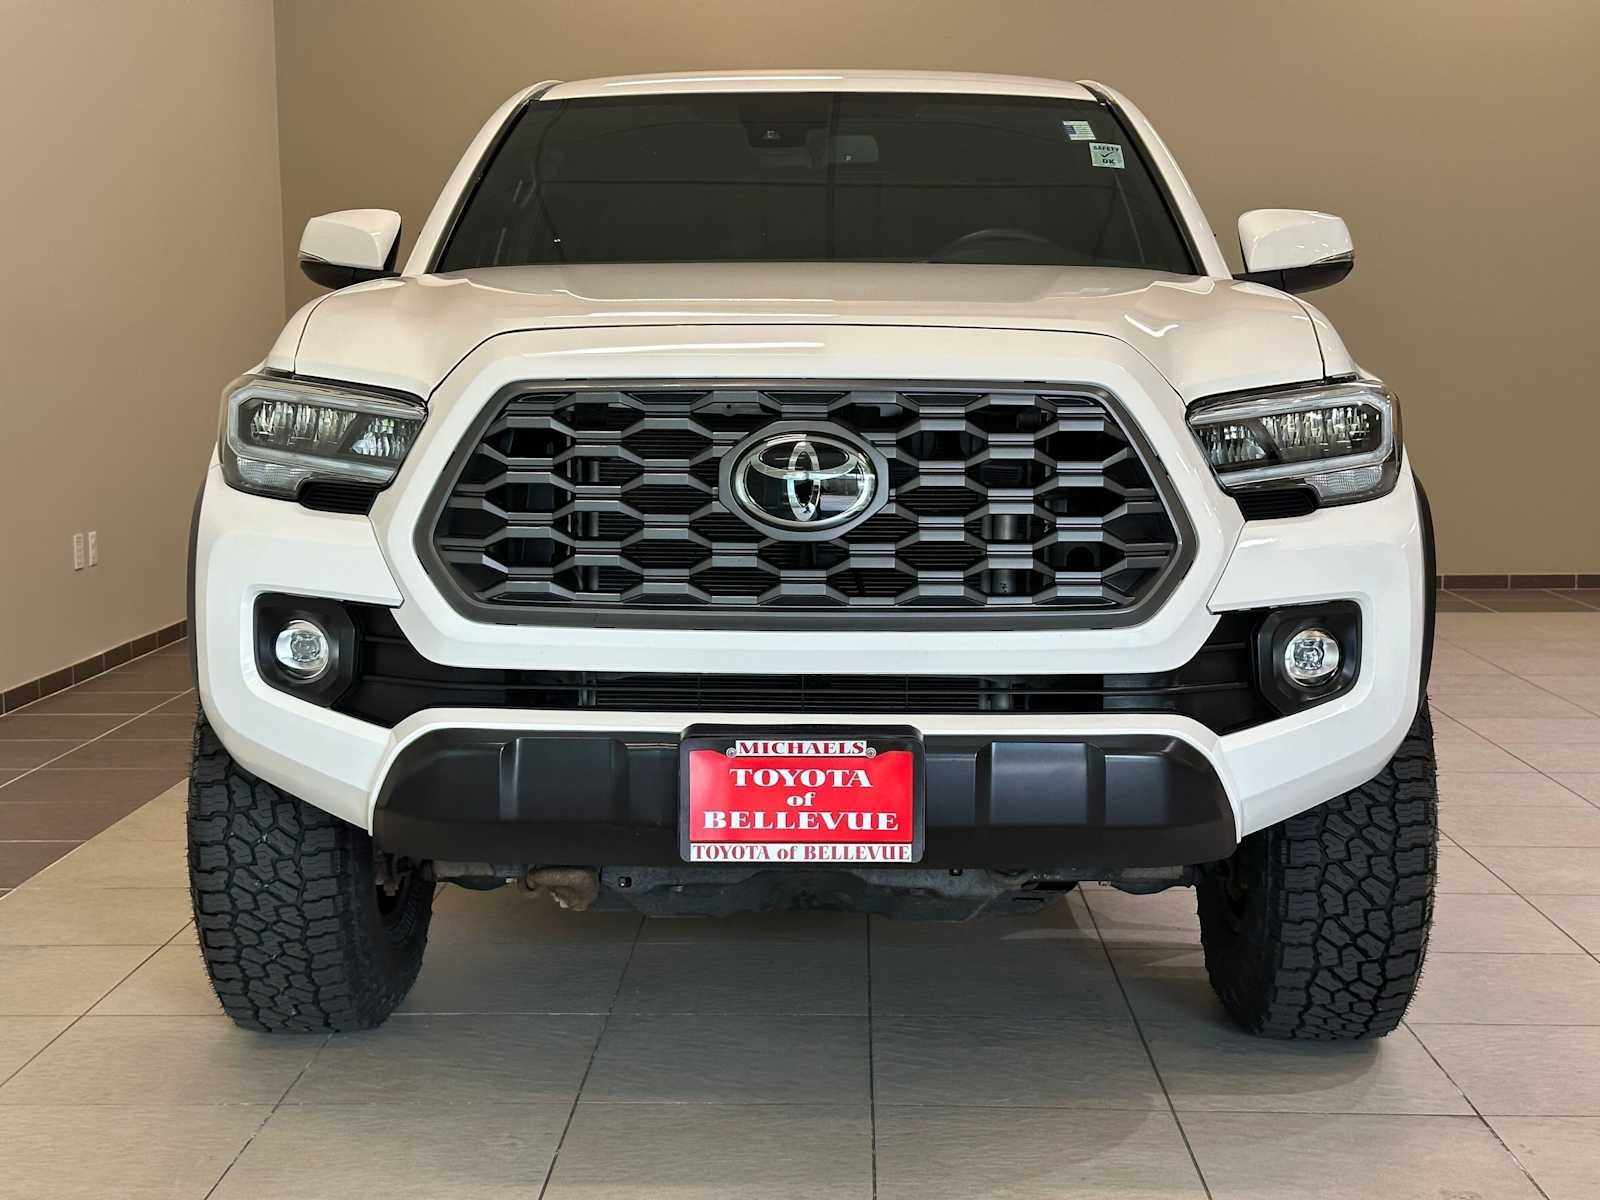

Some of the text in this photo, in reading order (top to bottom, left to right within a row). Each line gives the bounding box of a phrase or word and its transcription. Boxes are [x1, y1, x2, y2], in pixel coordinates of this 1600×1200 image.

[738, 742, 865, 755] MICHAELS
[729, 768, 872, 788] TOYOTA
[786, 791, 816, 807] of
[703, 811, 899, 831] BELLEVUE
[692, 845, 910, 861] TOYOTA of BELLEVUE
